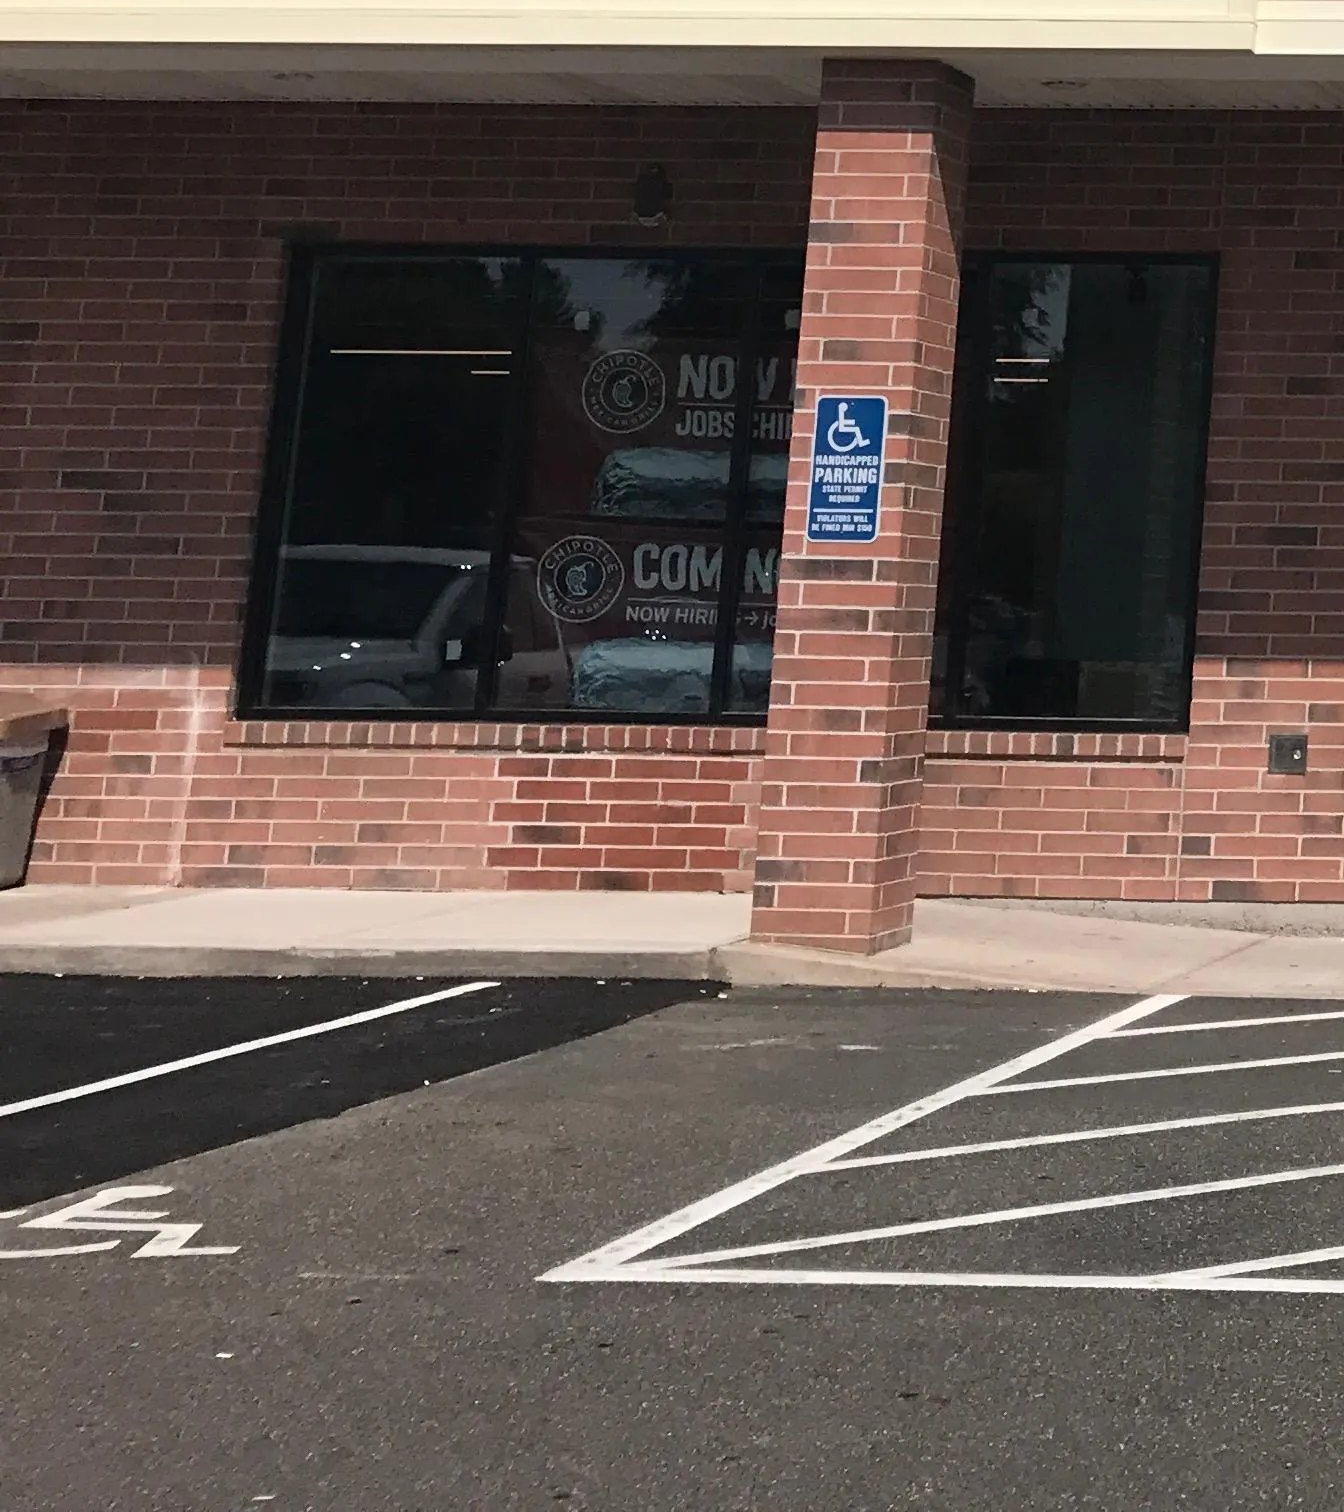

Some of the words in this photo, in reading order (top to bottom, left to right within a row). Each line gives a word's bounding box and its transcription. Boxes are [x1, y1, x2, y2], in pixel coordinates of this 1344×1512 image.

[815, 454, 879, 466] HANDICAPPED
[814, 467, 877, 484] PARKING
[822, 485, 842, 493] STATE
[544, 540, 619, 574] CHIPOTLE
[625, 605, 671, 623] NOW
